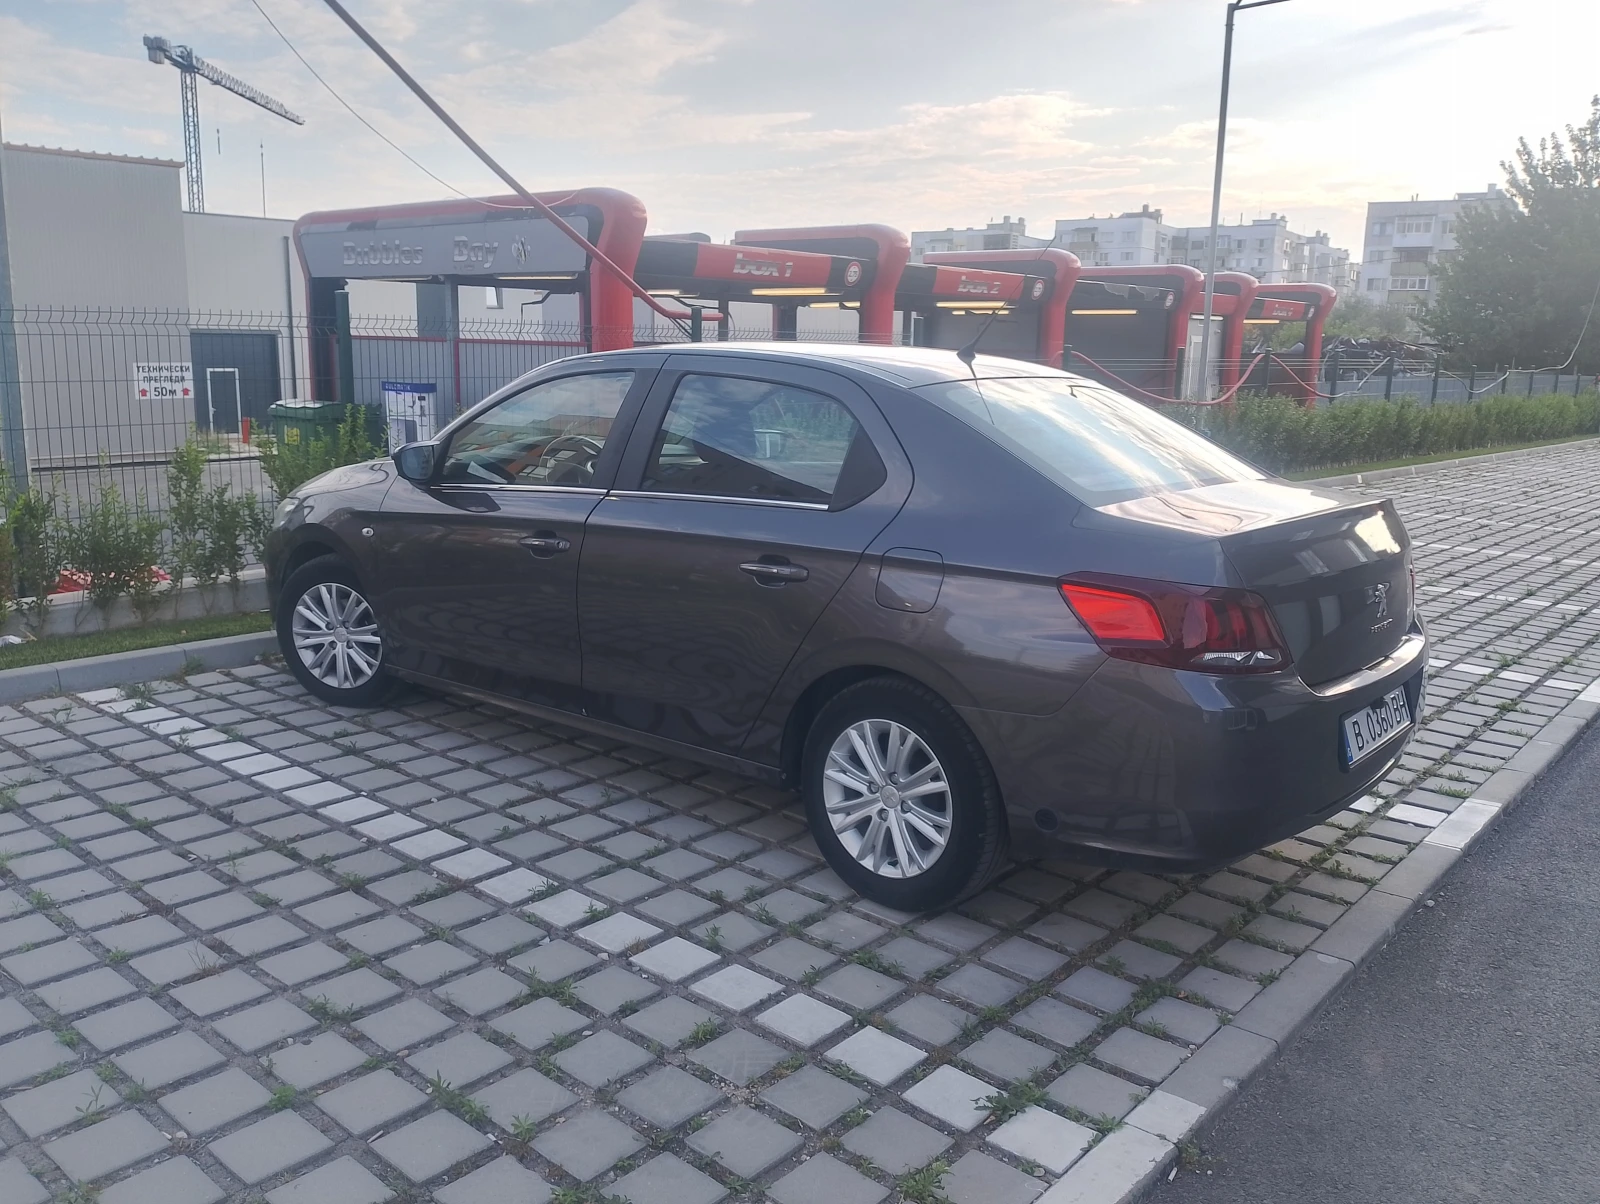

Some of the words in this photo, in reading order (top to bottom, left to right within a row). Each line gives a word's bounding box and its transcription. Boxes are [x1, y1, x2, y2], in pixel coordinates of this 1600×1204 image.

[343, 241, 423, 265] Bubbles
[453, 235, 498, 268] Bay
[733, 252, 781, 277] box
[784, 262, 793, 277] 1
[136, 365, 191, 373] ТЕХНИЧЕСКИ
[142, 375, 186, 384] ПРЕГЛЕДИ
